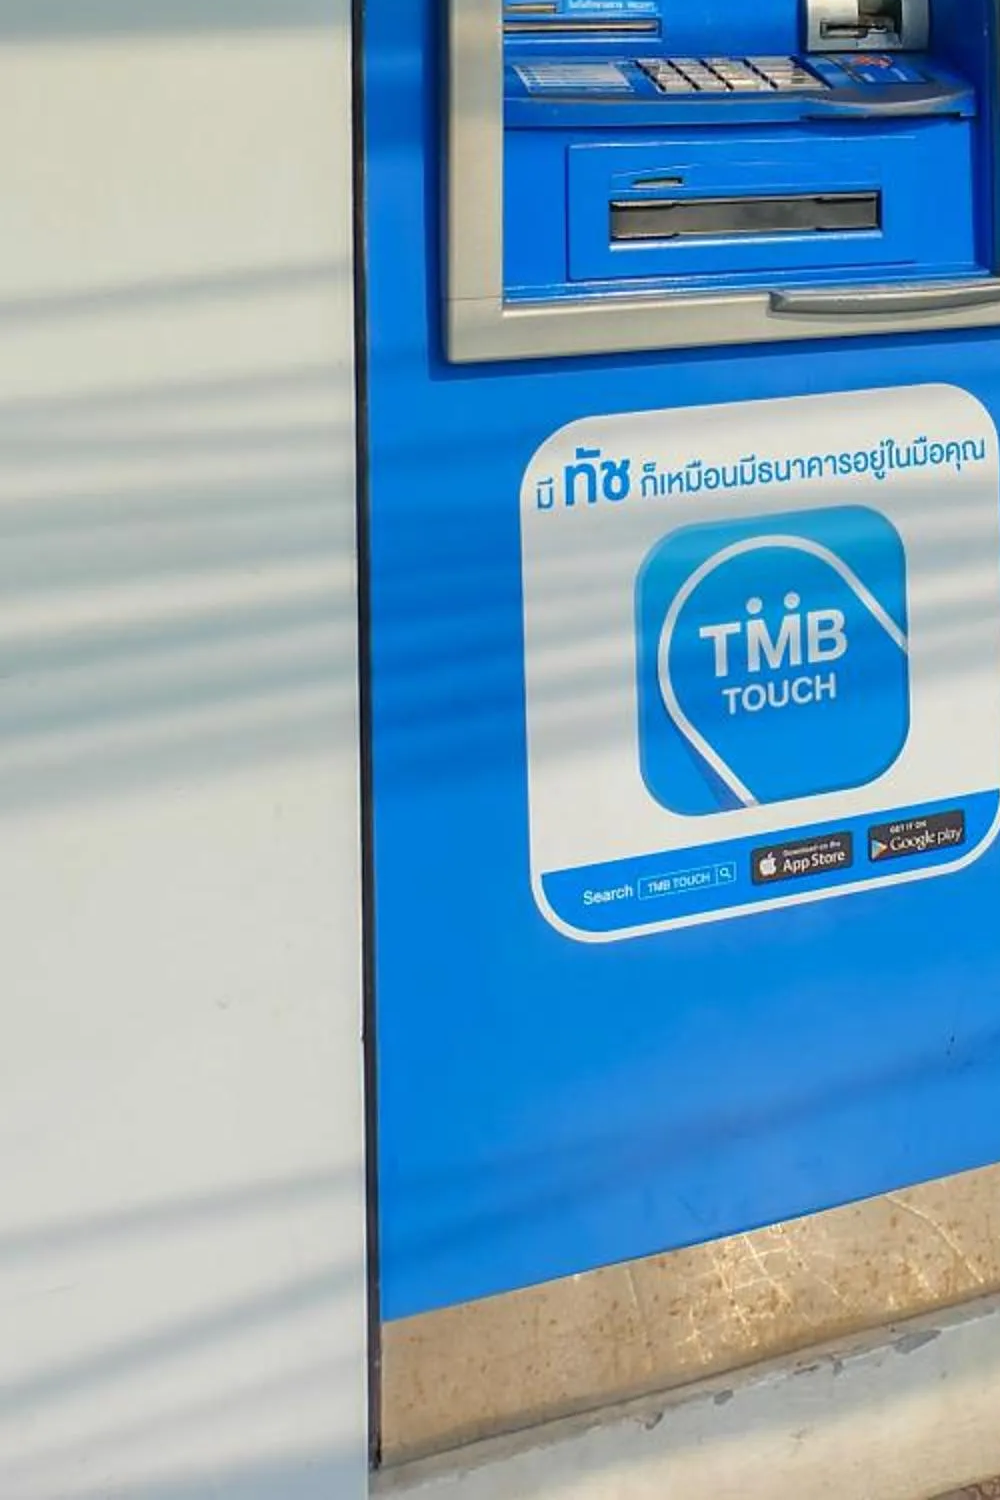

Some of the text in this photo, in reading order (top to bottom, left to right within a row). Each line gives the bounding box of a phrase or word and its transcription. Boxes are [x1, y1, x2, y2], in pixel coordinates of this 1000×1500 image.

[536, 477, 555, 510] มี
[563, 446, 631, 507] ทัช
[699, 592, 848, 678] TMB
[723, 674, 837, 715] TOUCH
[889, 828, 963, 852] Google play
[783, 849, 846, 875] App Store
[583, 884, 634, 905] Search
